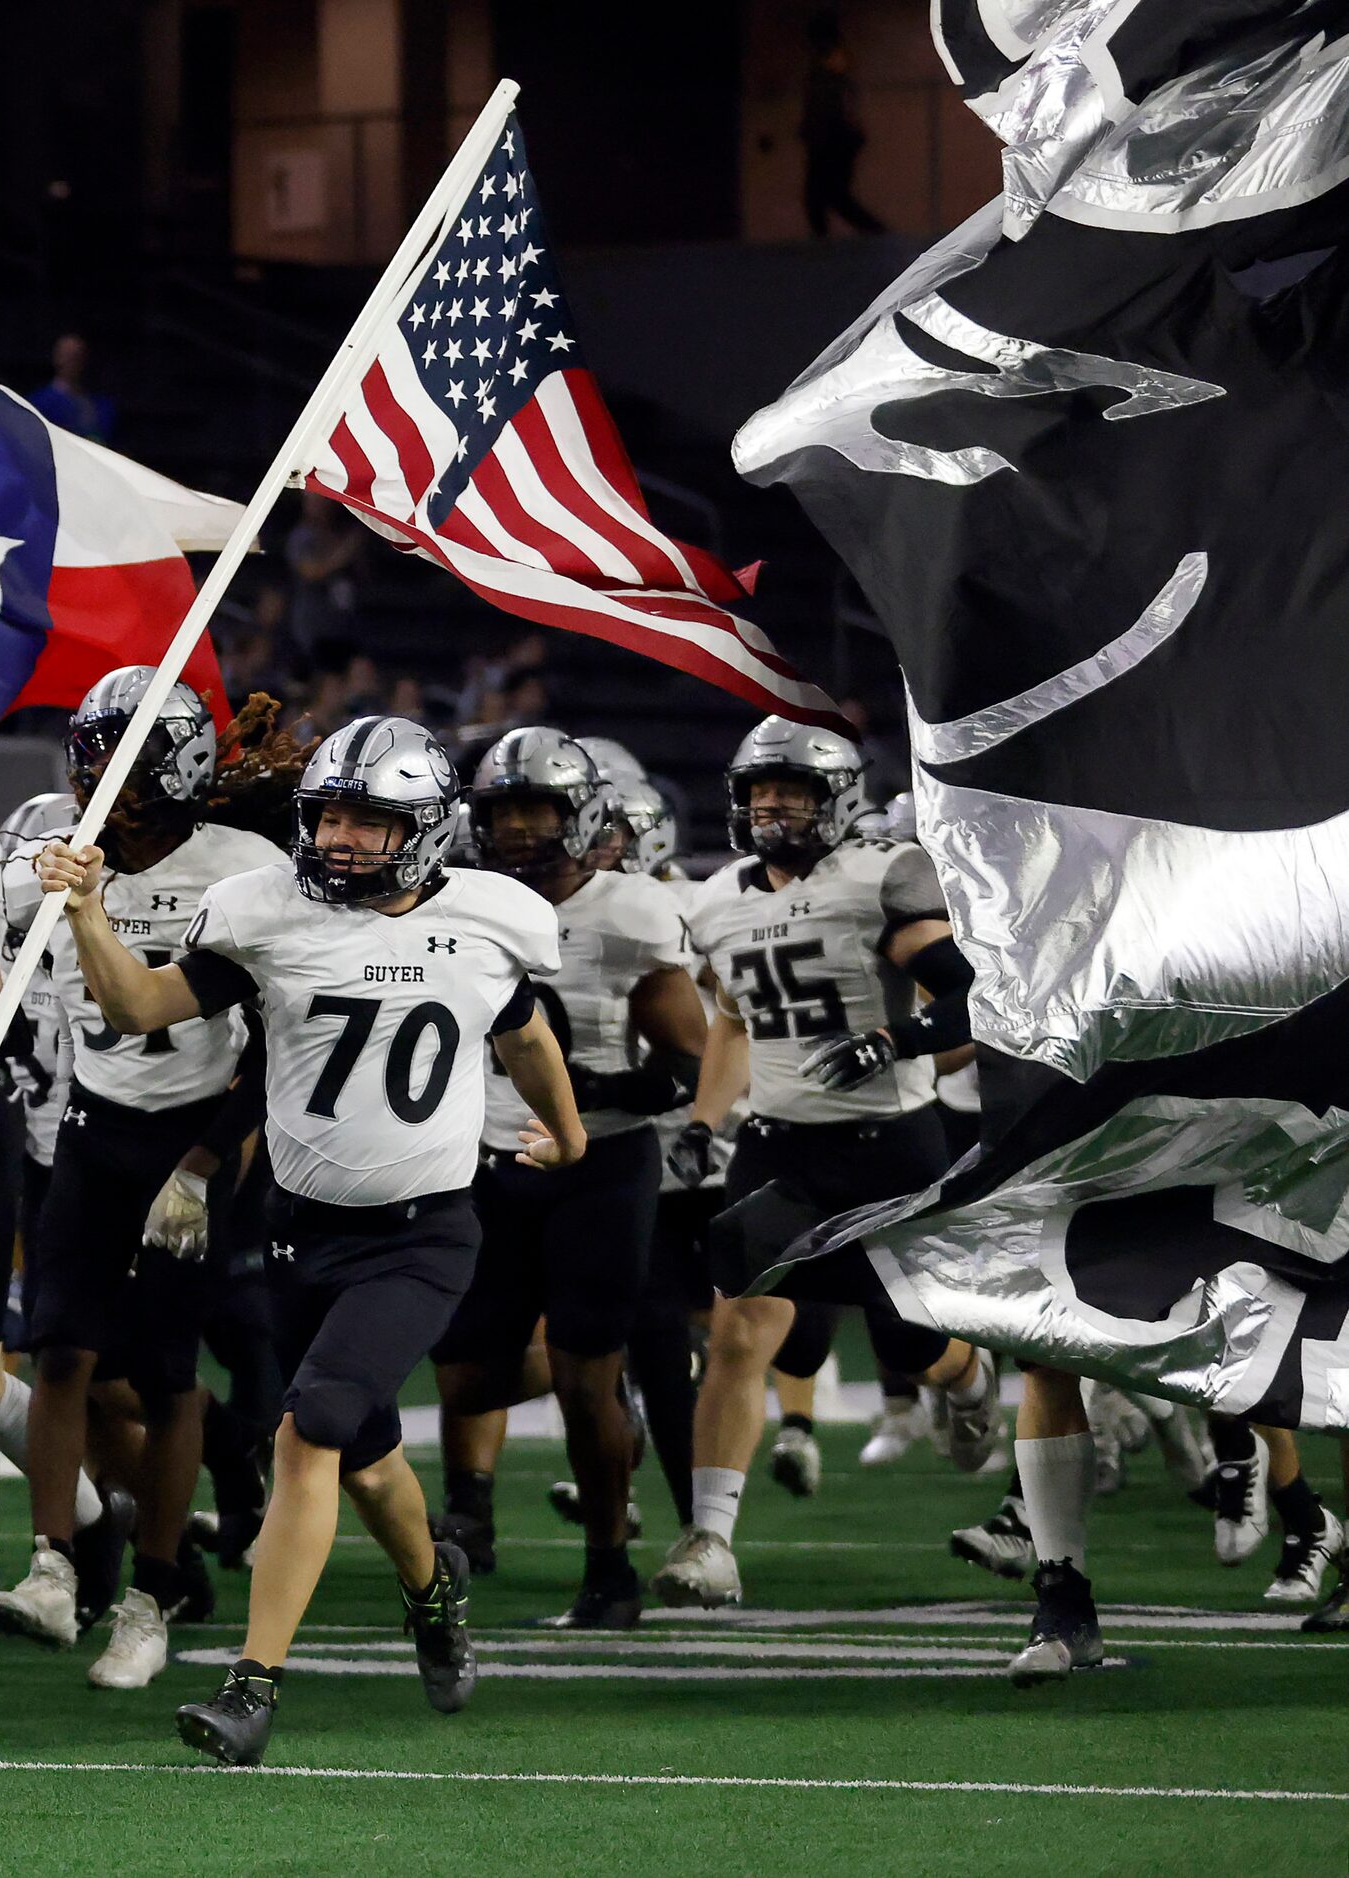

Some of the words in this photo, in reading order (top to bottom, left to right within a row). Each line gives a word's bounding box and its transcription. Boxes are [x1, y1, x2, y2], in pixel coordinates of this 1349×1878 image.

[107, 917, 151, 935] UYER
[752, 923, 789, 942] GUYER
[364, 965, 425, 983] GUYER
[730, 938, 850, 1040] 35
[304, 995, 461, 1126] 70
